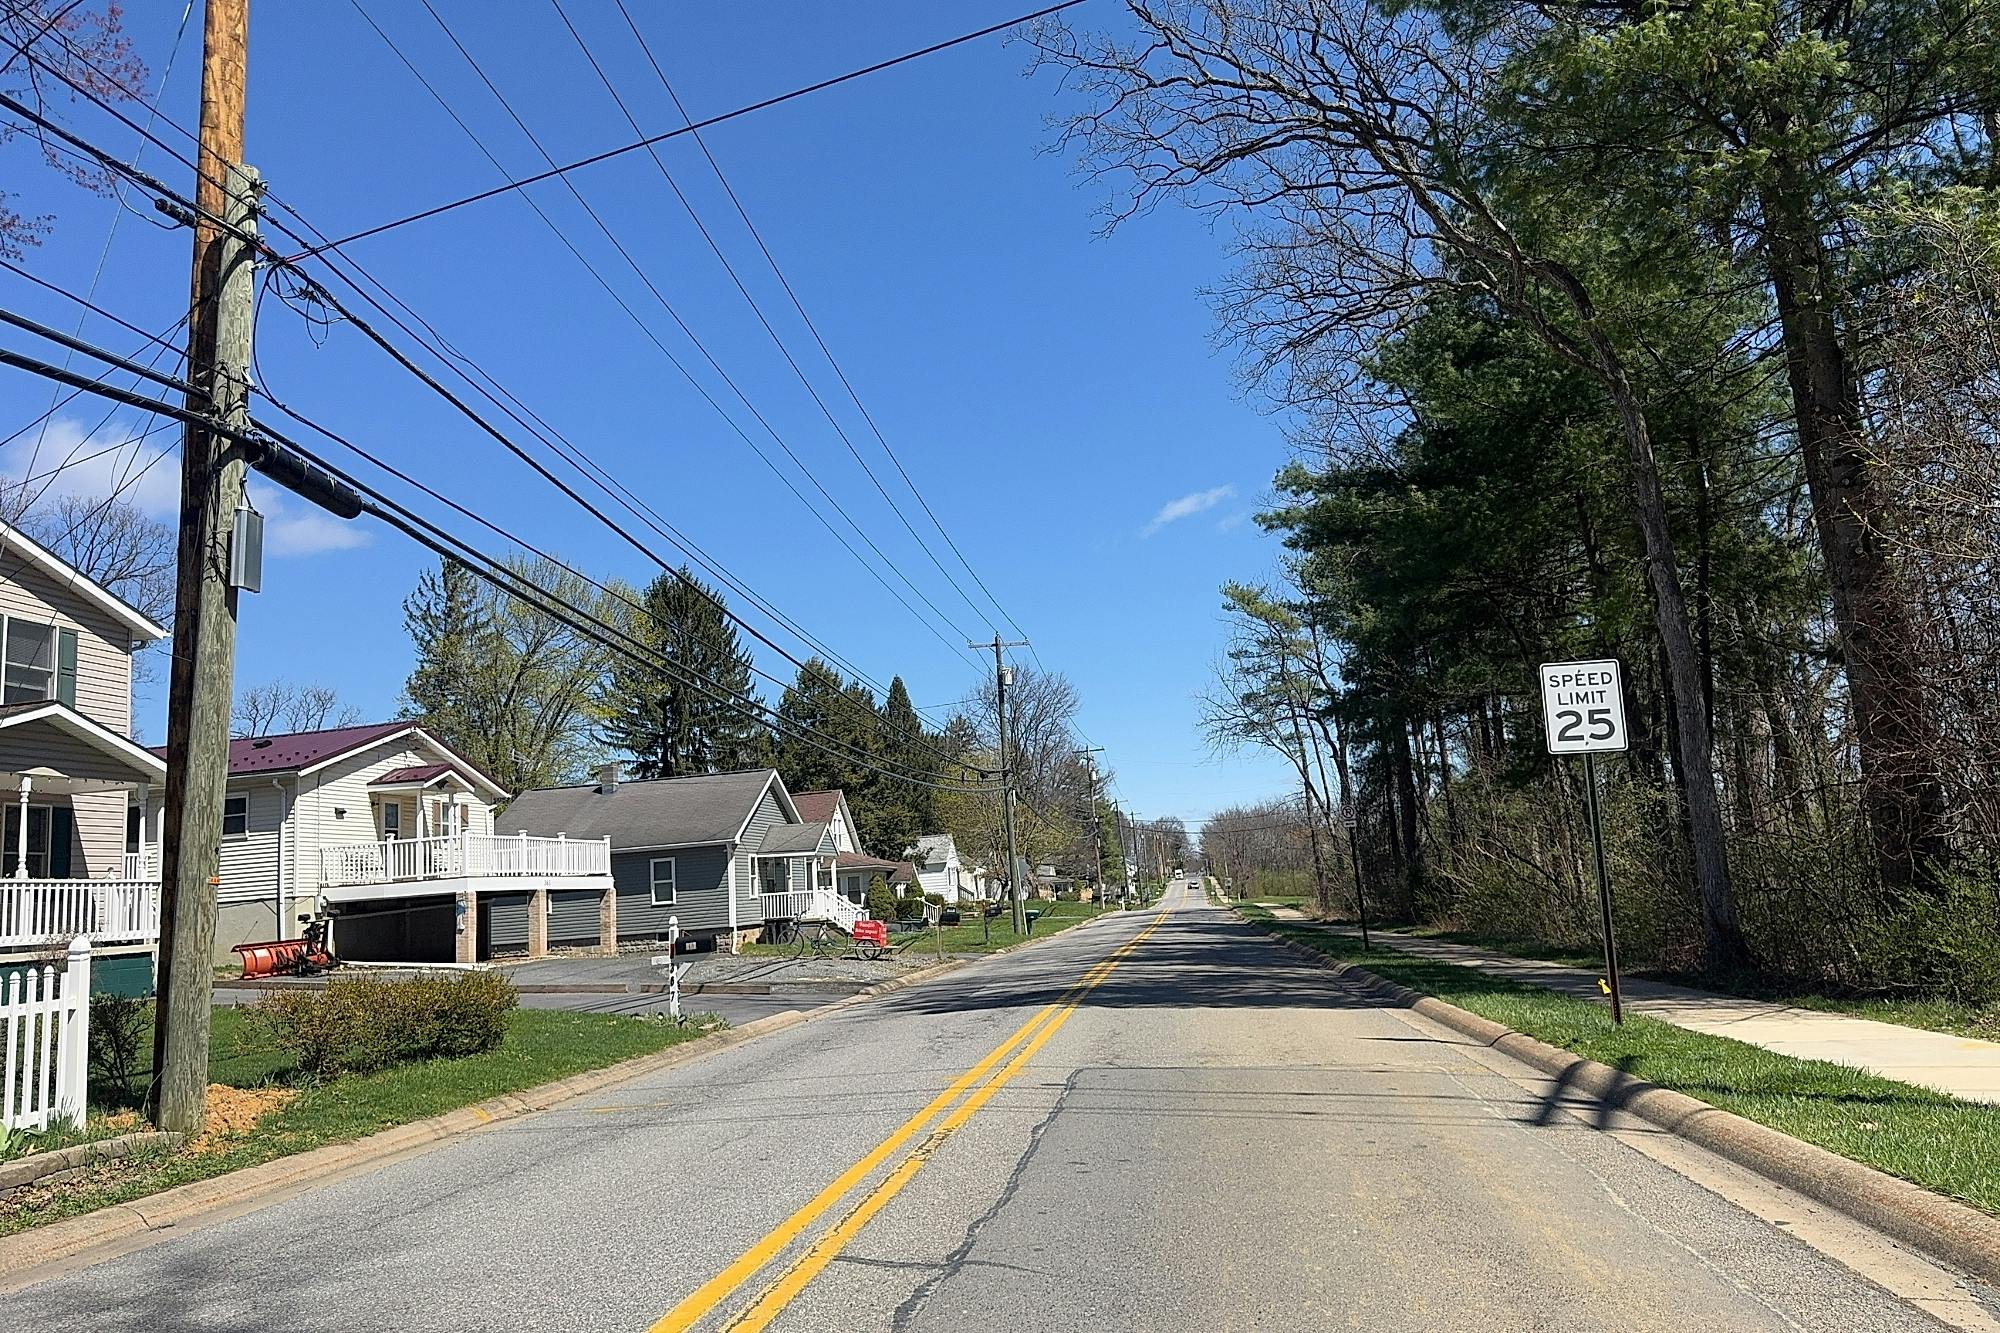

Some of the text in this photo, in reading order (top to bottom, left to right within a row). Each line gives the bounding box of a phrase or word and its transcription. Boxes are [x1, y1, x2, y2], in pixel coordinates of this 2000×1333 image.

[1549, 671, 1613, 688] SPEED
[1557, 690, 1607, 706] LIMIT
[1555, 708, 1616, 742] 25
